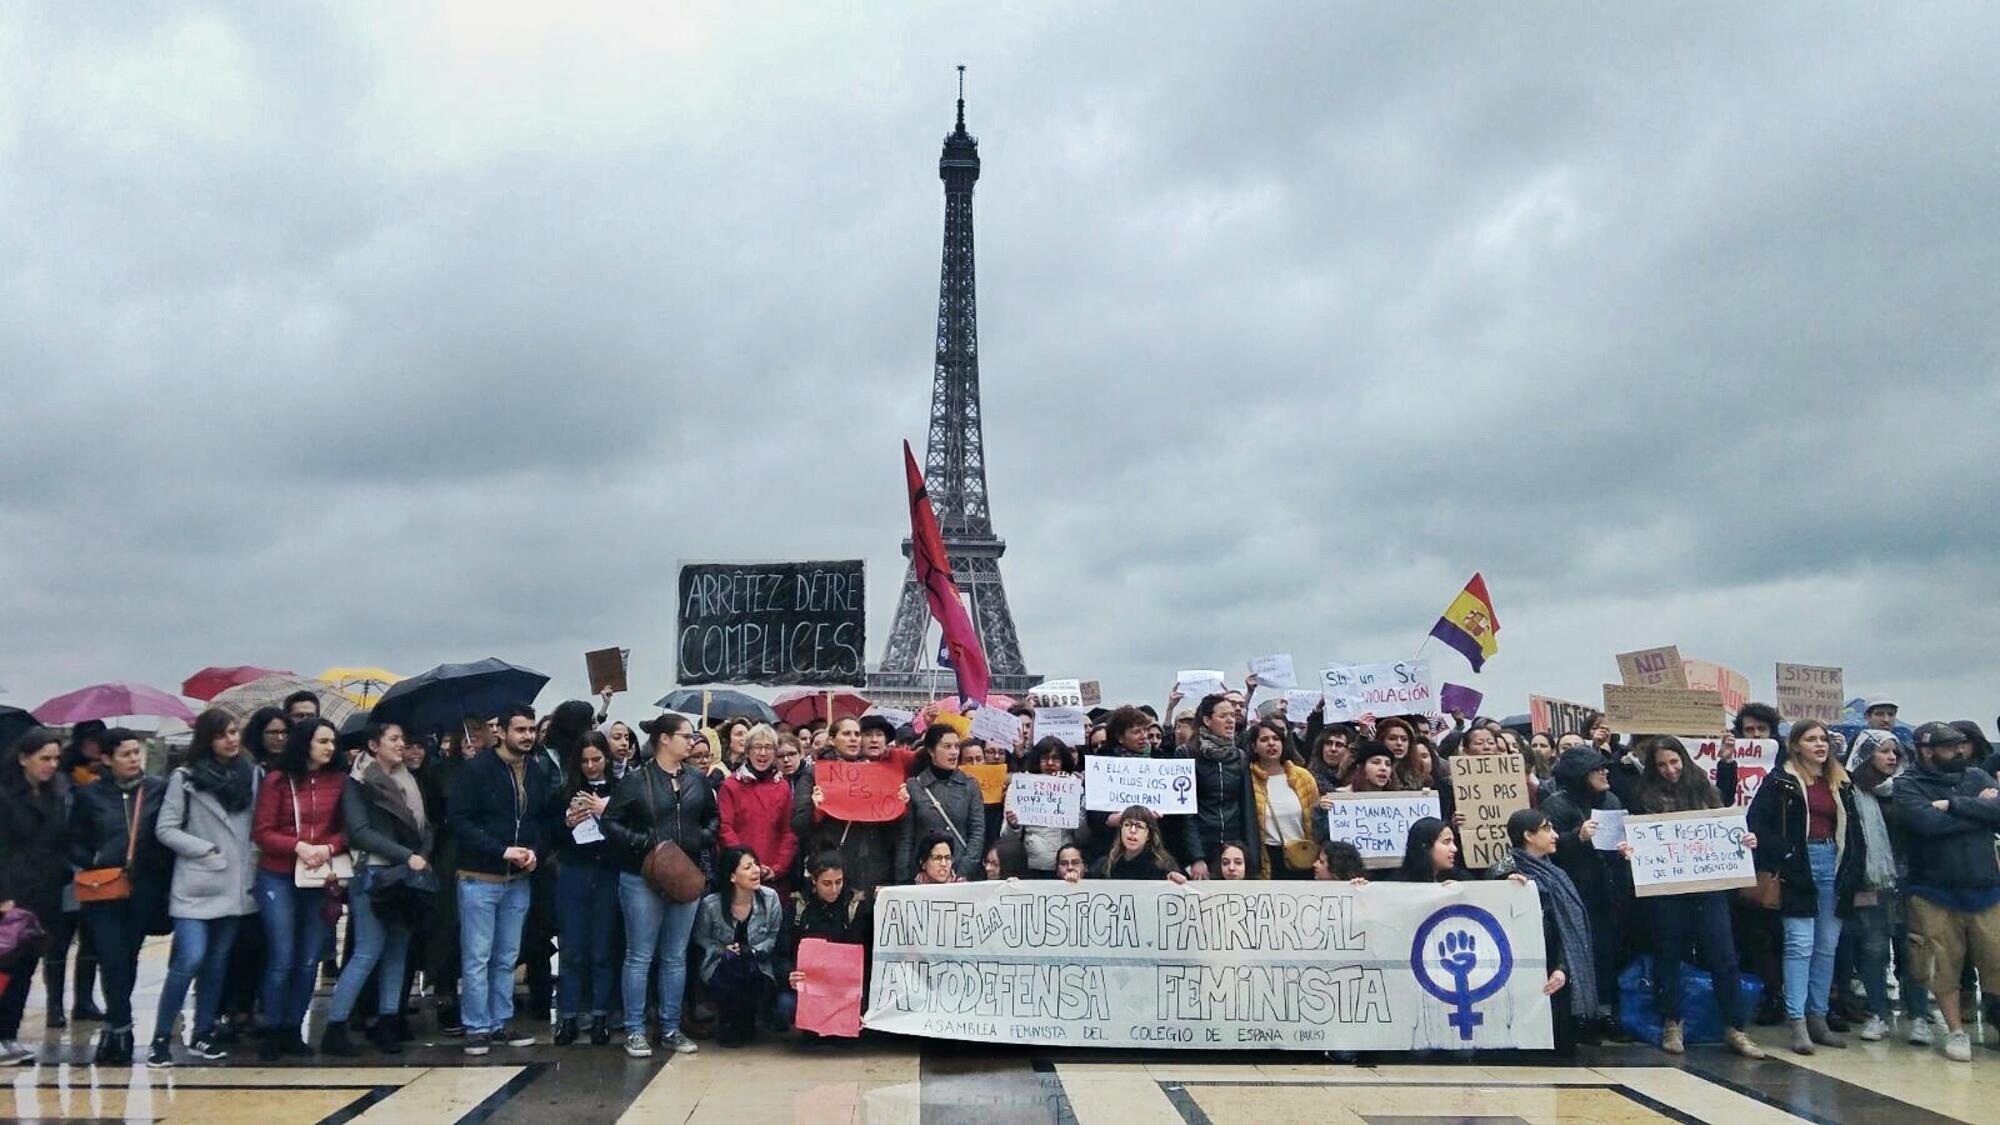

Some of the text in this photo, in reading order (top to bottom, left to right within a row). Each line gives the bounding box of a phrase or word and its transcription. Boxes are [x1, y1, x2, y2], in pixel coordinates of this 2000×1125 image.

[685, 569, 861, 618] ARRÊTEZ D'ÊTRE
[680, 621, 859, 677] COMPLICES
[1634, 652, 1667, 673] NO
[1360, 674, 1375, 685] un
[1785, 666, 1839, 685] SISTER
[1335, 698, 1347, 708] es
[1362, 683, 1430, 703] VIOLACIÓN
[829, 764, 860, 784] NO
[1093, 762, 1192, 776] A ELLA LA CULPAN
[1456, 756, 1520, 776] SI JE NE
[1108, 775, 1114, 783] A
[849, 784, 872, 799] ES
[1016, 791, 1063, 806] pays des
[1457, 783, 1517, 800] DIS PAS
[870, 794, 896, 818] NO
[1332, 803, 1431, 820] LA MANADA NO
[1478, 804, 1500, 821] OUI
[1333, 819, 1350, 828] SON
[1377, 821, 1391, 834] ES
[1648, 824, 1665, 841] TE
[1634, 855, 1641, 867] Y
[880, 899, 975, 948] ANTE
[976, 905, 1004, 945] LA
[877, 960, 1110, 1021] AUTODEFENSA
[923, 1018, 998, 1037] ASAMBLEA
[1010, 1024, 1067, 1039] FEMINISTA
[1083, 1025, 1109, 1040] DEL
[1130, 1025, 1194, 1042] COLEGIO
[1205, 1027, 1222, 1042] DE
